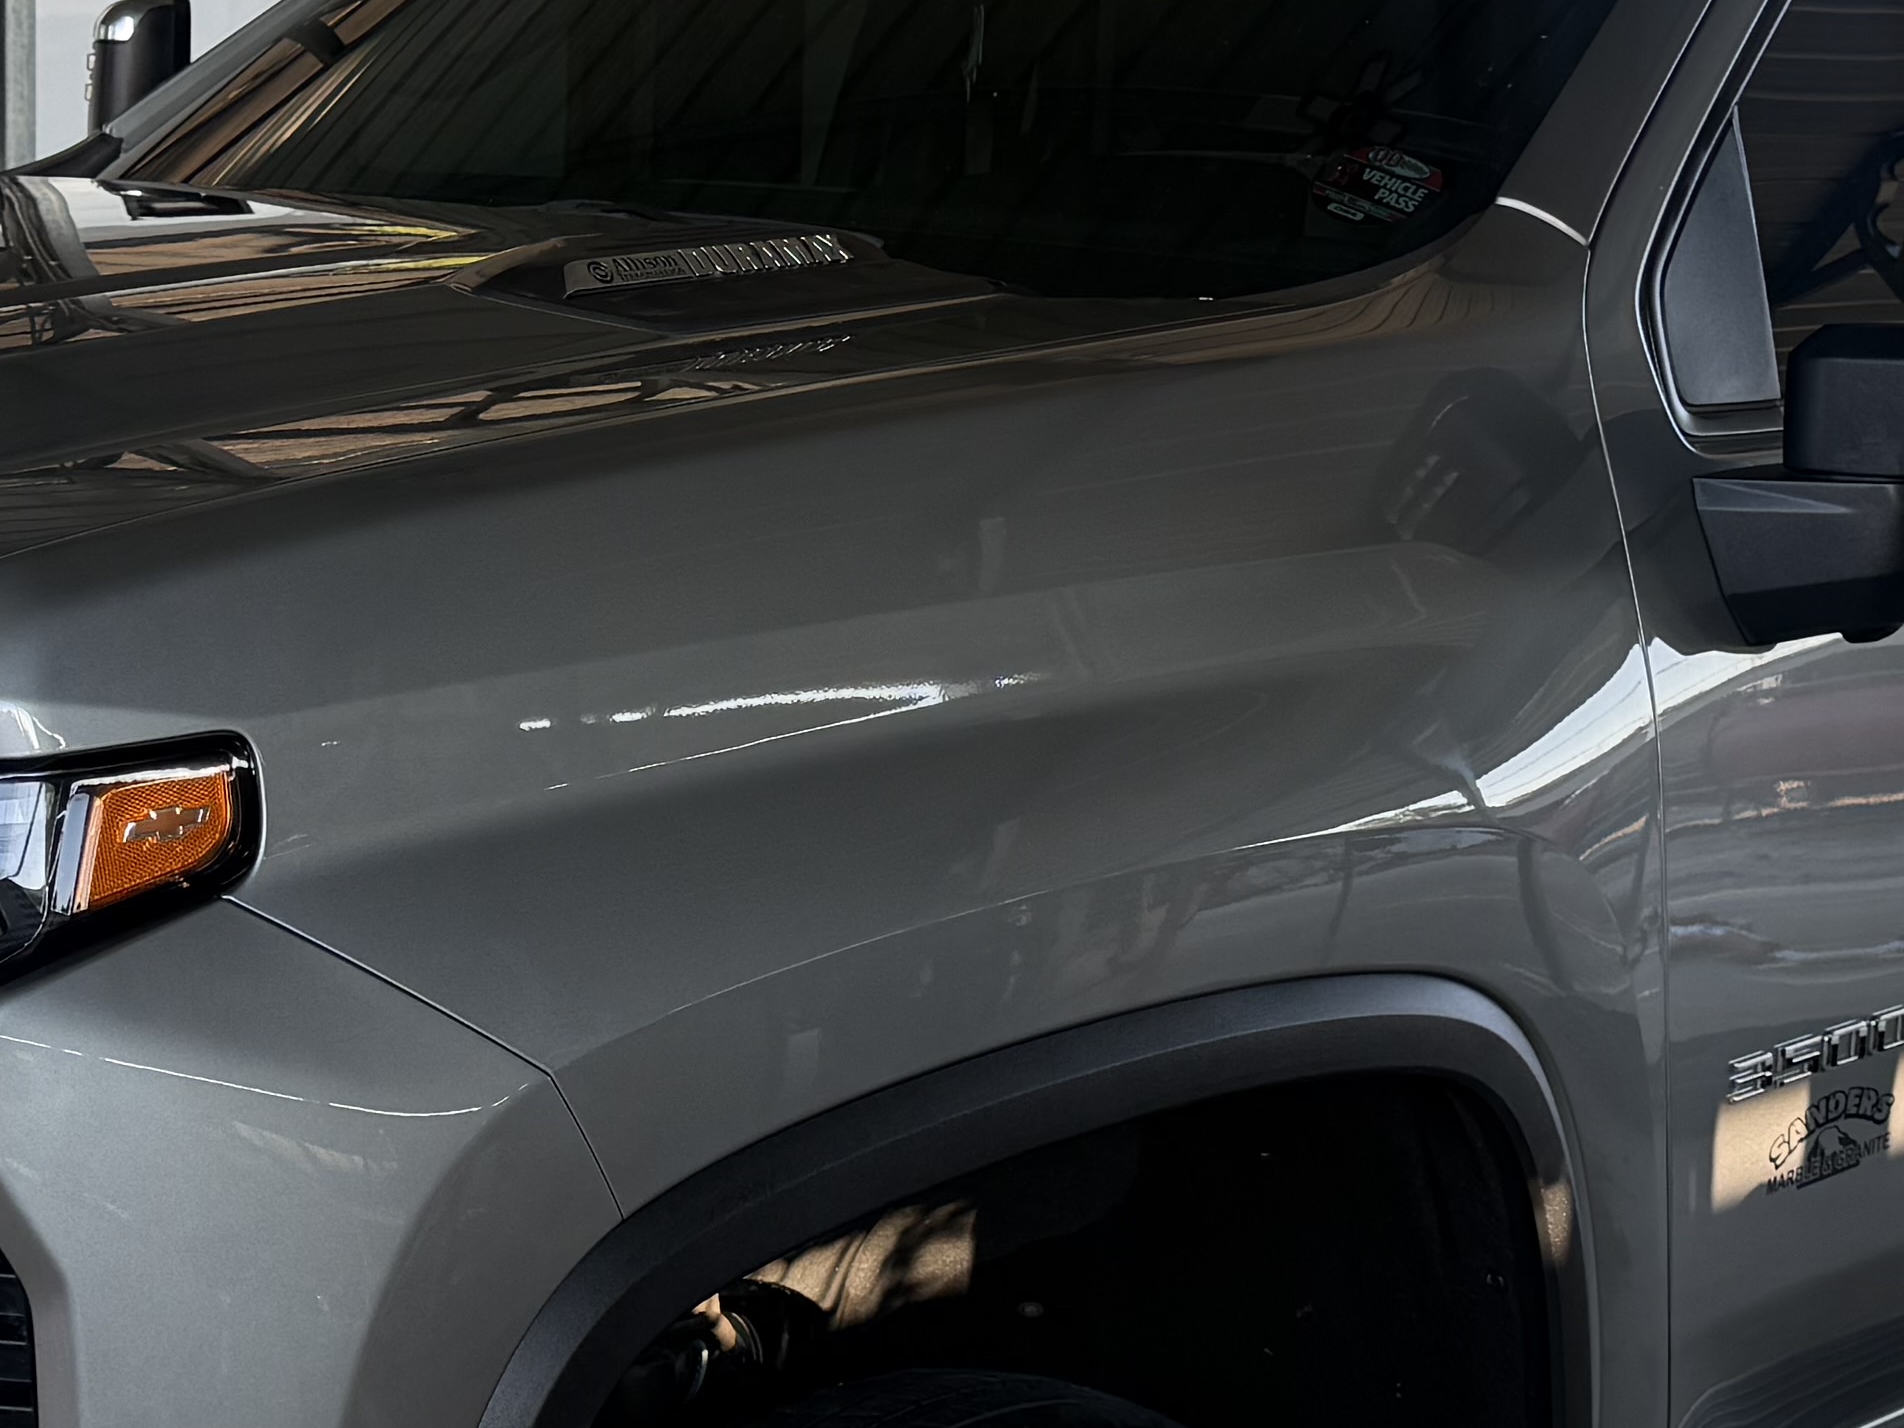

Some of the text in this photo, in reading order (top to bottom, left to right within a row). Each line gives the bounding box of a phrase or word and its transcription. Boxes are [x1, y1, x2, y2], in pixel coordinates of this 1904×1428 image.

[1362, 167, 1428, 202] VEHICLE
[1374, 187, 1420, 213] PASS
[611, 254, 678, 274] Allison
[677, 233, 856, 278] DURAMAX
[1768, 1086, 1896, 1171] SANDERS
[1765, 1158, 1820, 1195] MARBLE
[1832, 1131, 1891, 1172] GRANITE
